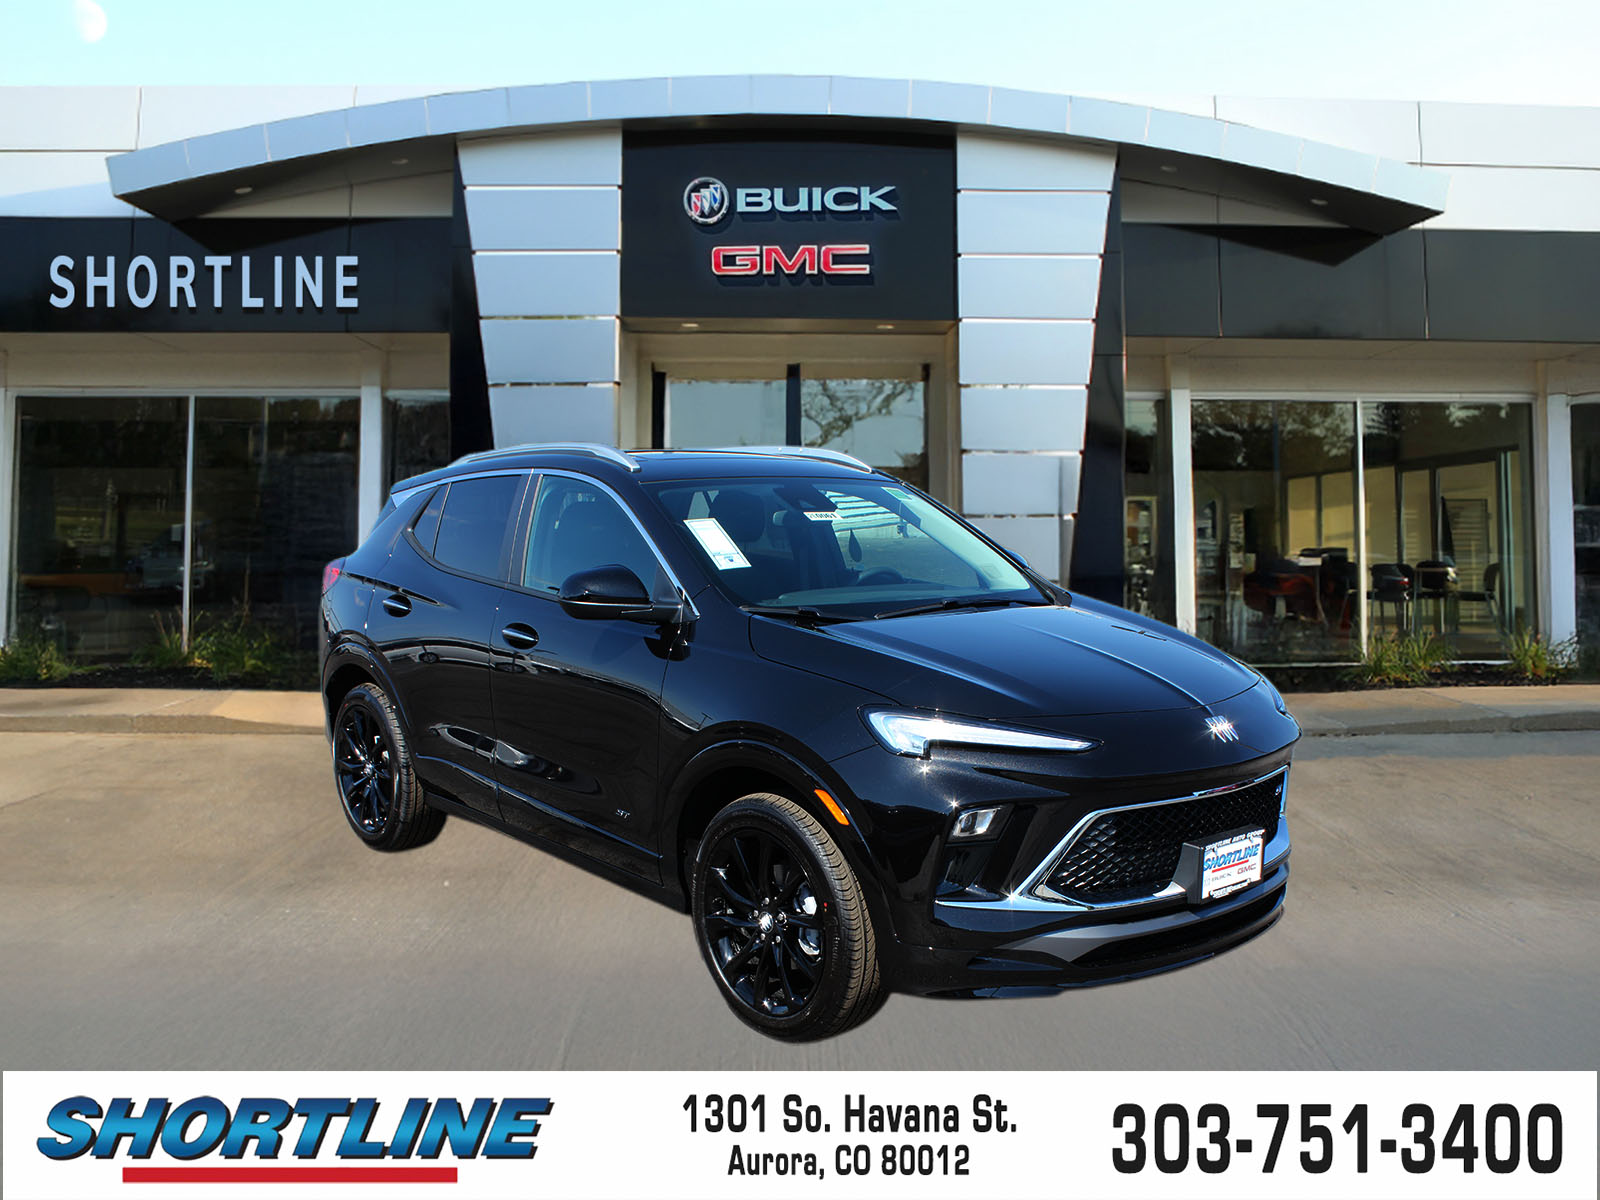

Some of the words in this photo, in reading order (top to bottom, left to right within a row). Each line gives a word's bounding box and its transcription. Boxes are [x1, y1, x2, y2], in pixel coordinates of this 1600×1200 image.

[736, 186, 898, 213] BUICK
[711, 244, 870, 276] GMC
[49, 255, 359, 308] SHORTLINE
[1203, 843, 1261, 871] SHORTLINE
[1237, 863, 1257, 875] GMC
